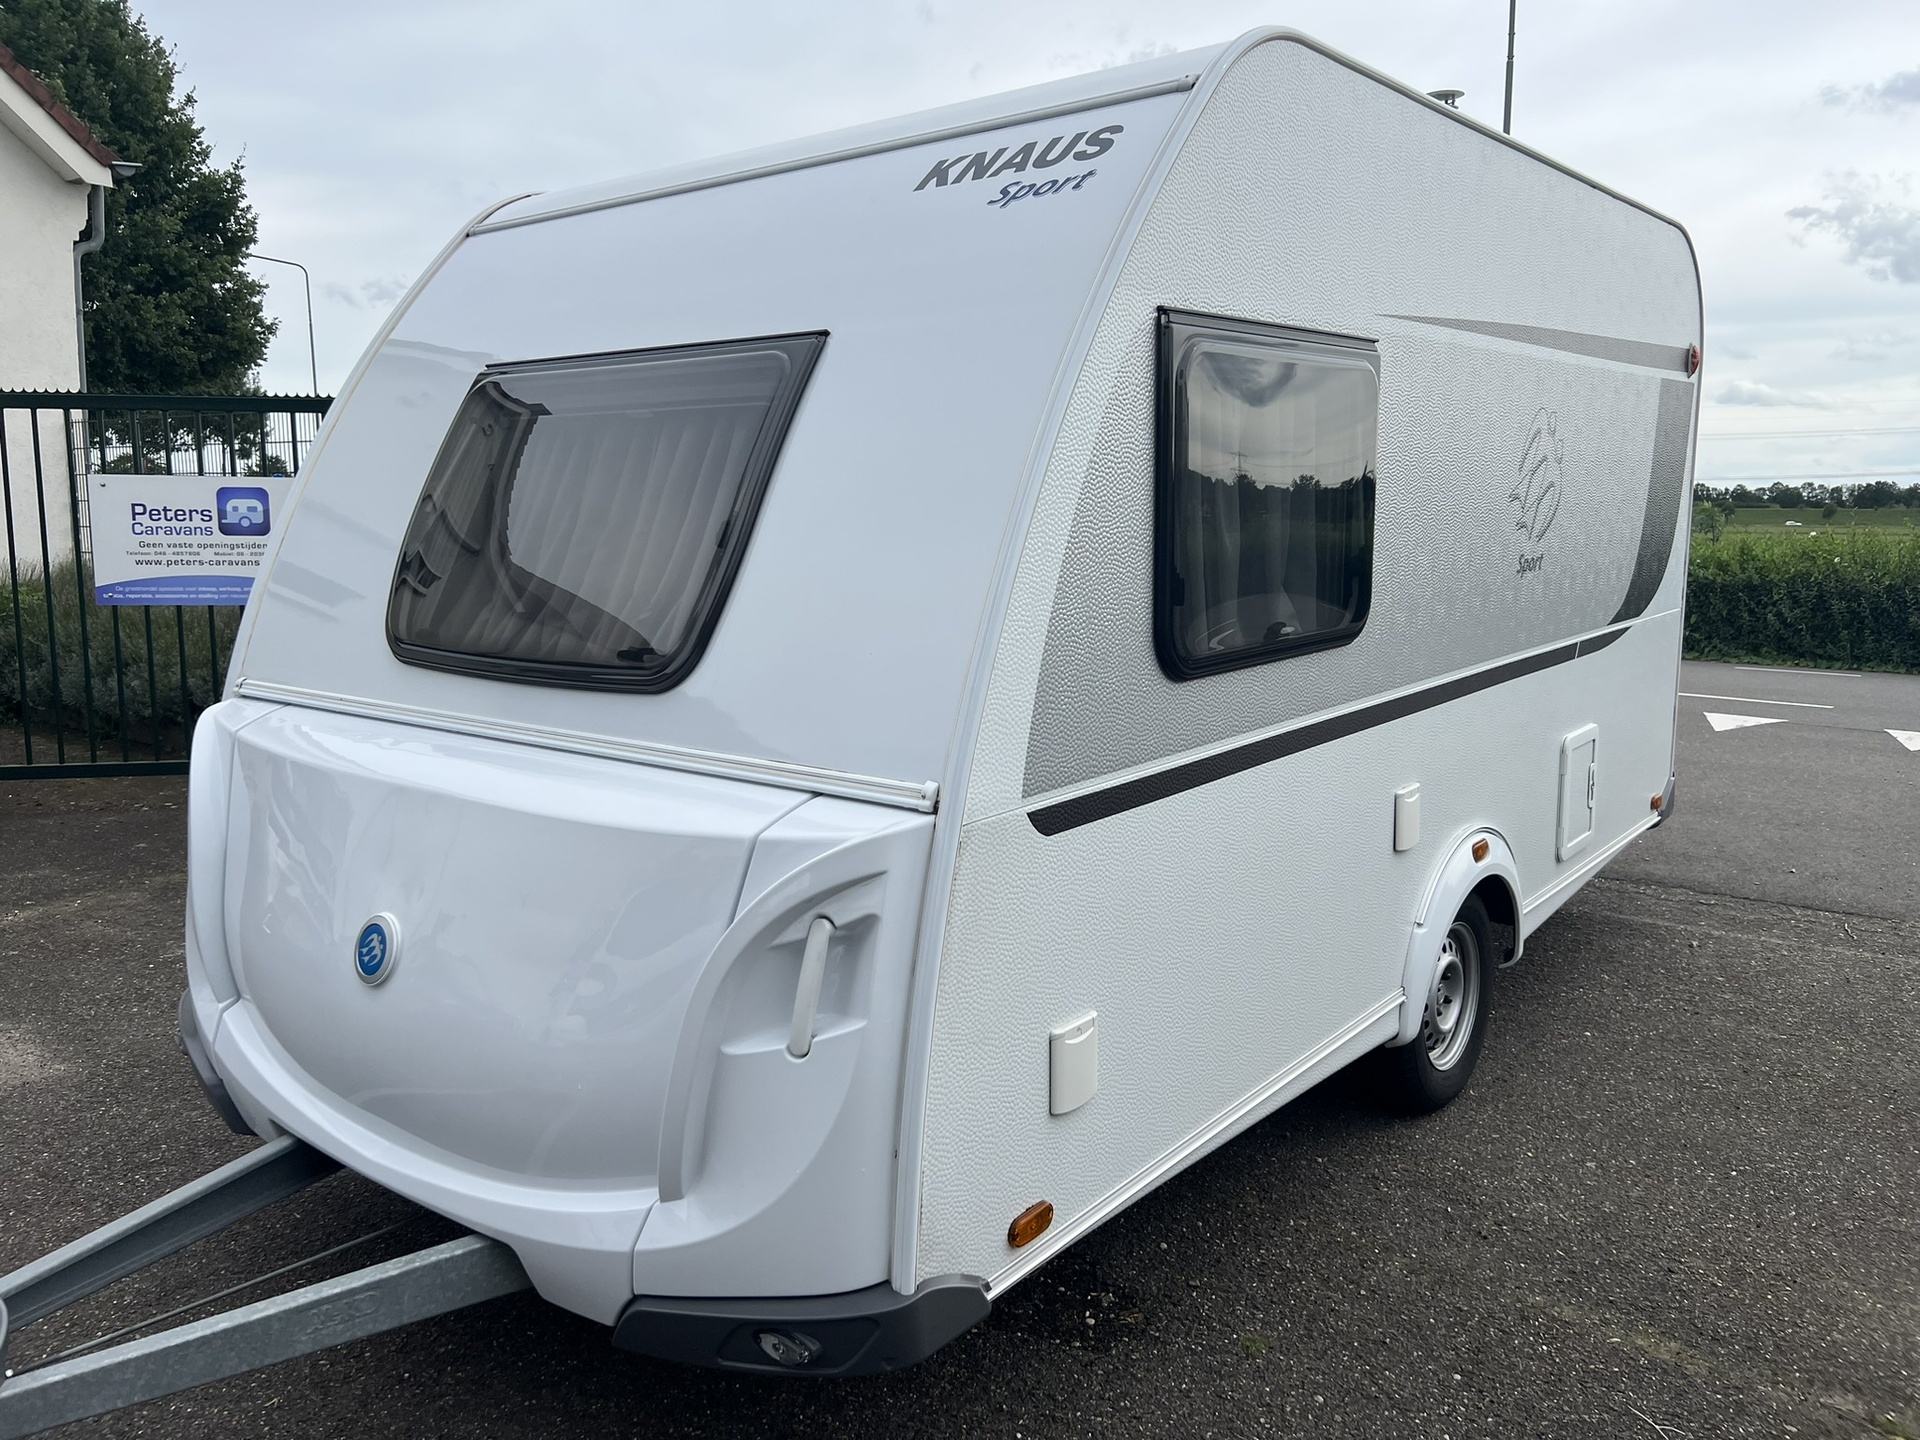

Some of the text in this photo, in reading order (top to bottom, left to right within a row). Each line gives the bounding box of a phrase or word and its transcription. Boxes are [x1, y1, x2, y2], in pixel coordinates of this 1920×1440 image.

[912, 124, 1125, 192] KNAUS
[986, 169, 1098, 209] Sport
[131, 502, 213, 522] Peters
[131, 522, 214, 536] Caravans
[138, 540, 164, 549] Geen
[1515, 553, 1544, 579] Sport
